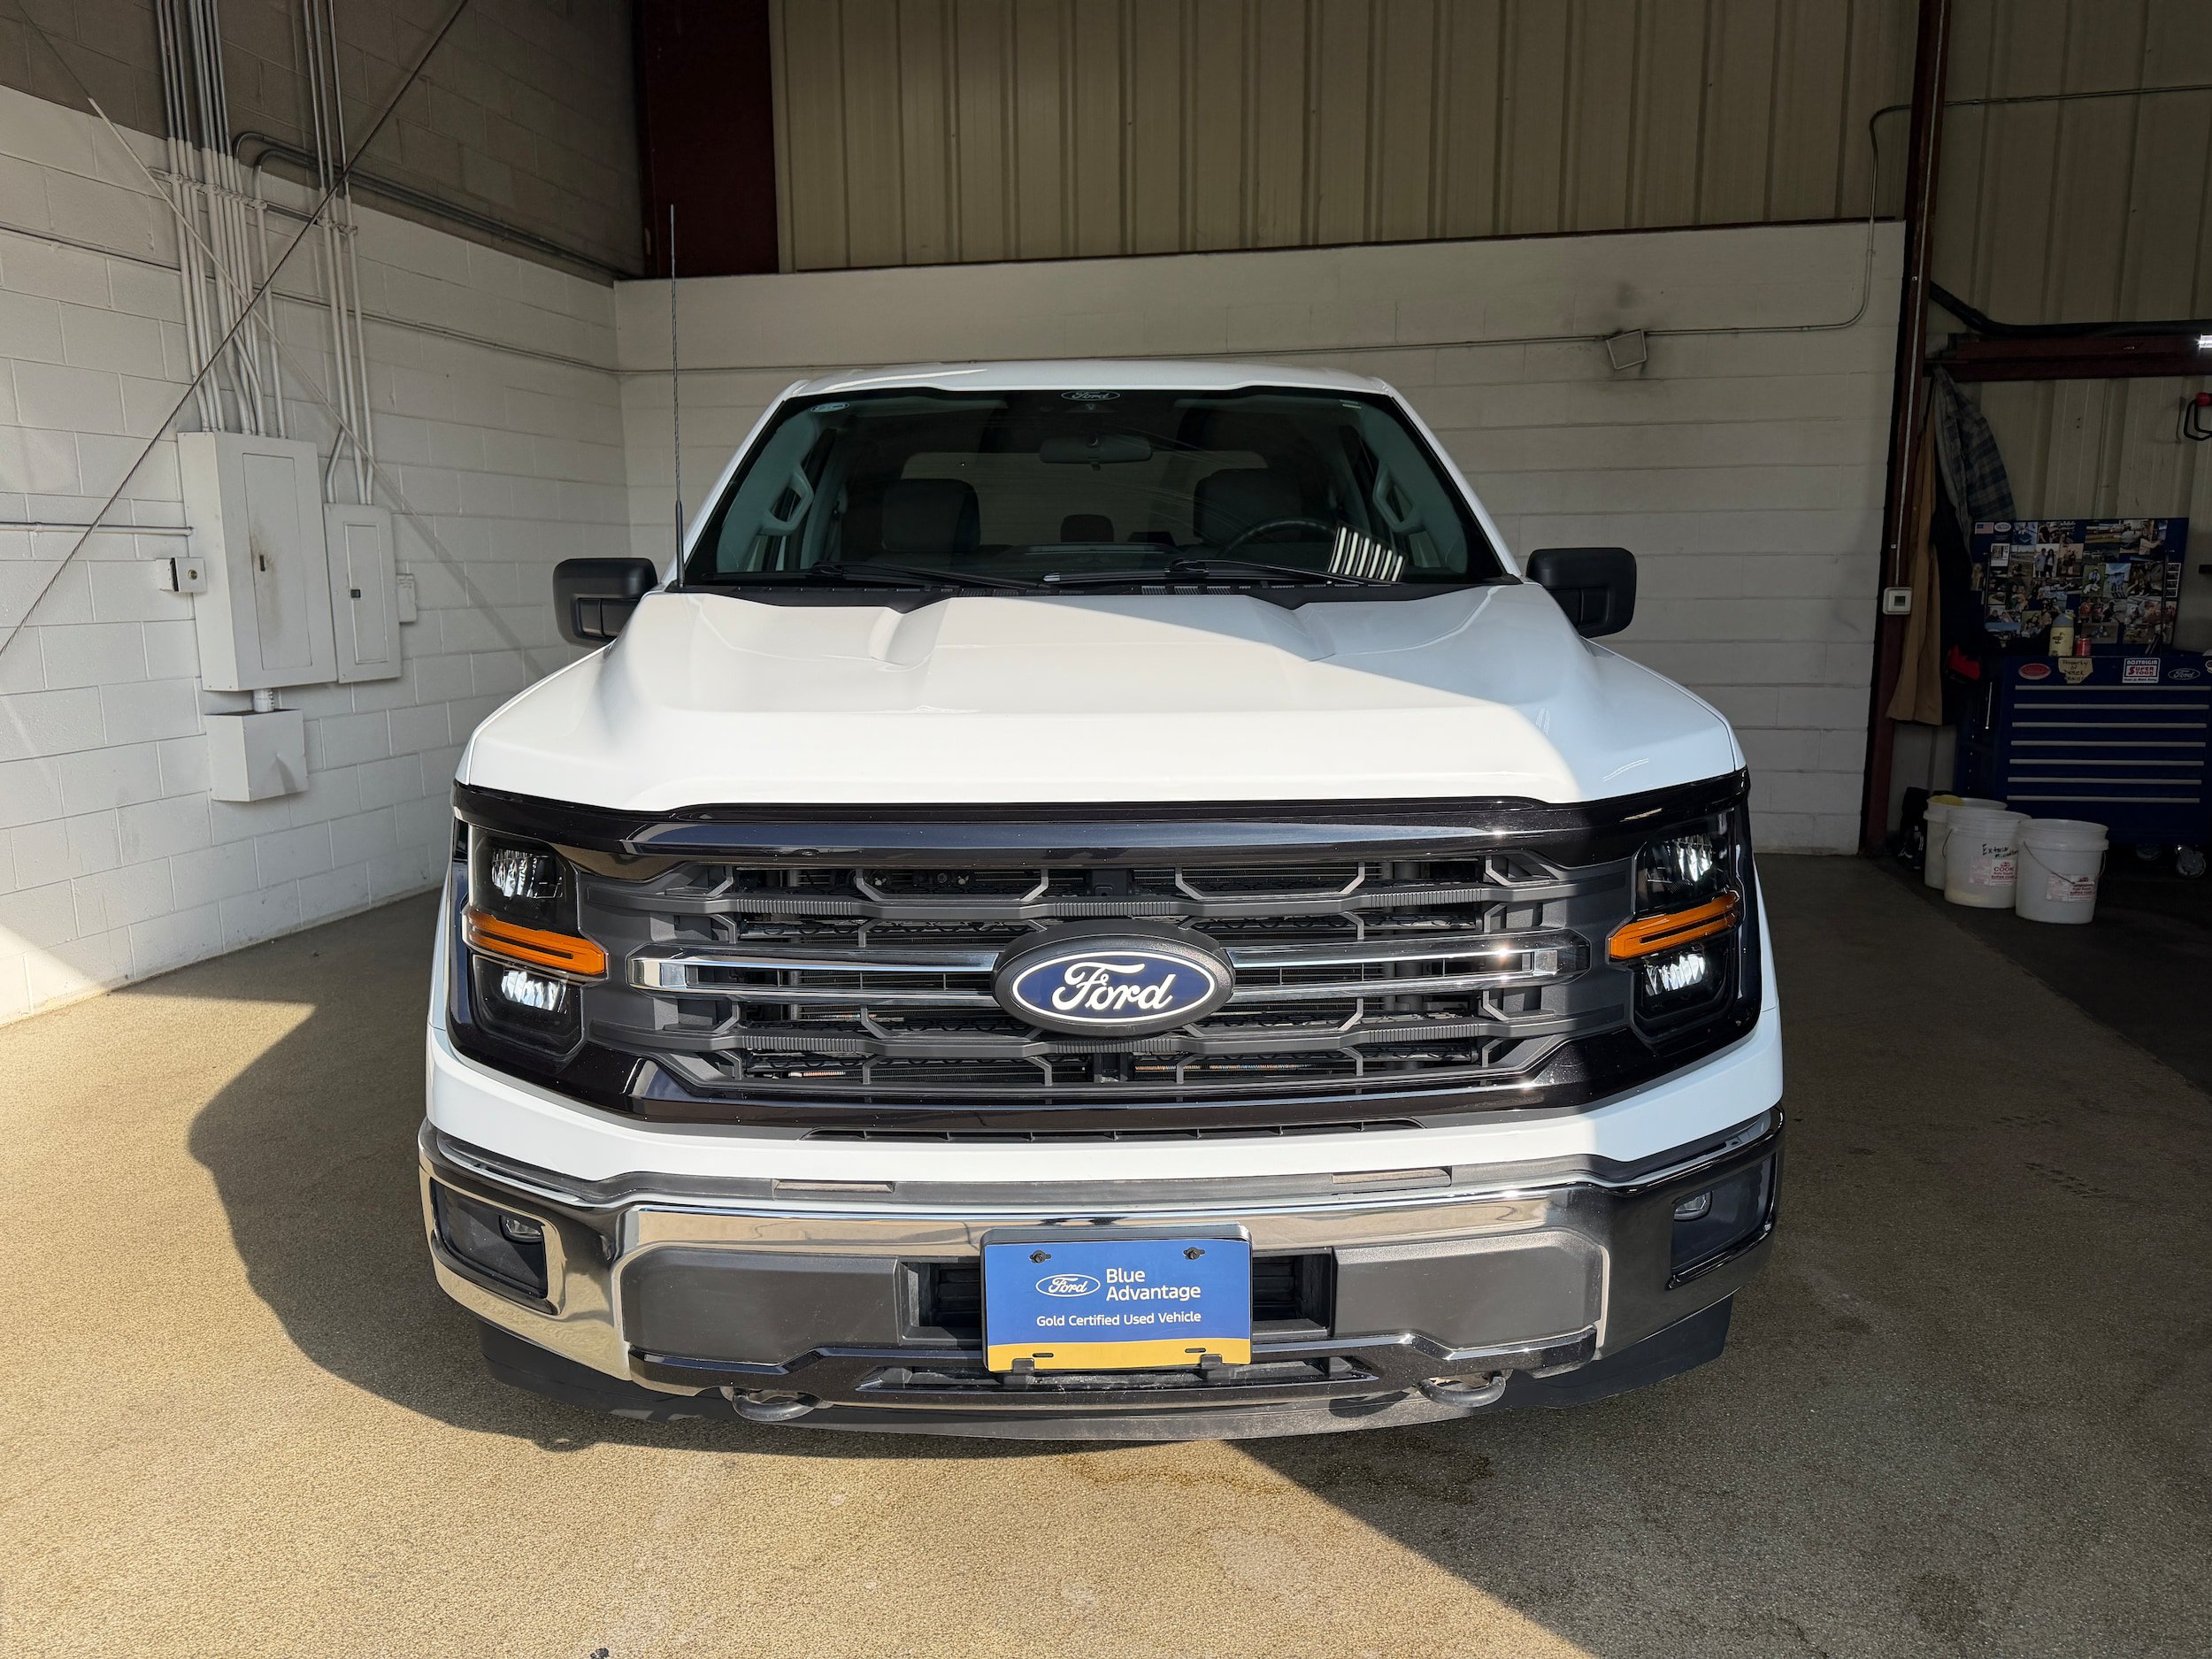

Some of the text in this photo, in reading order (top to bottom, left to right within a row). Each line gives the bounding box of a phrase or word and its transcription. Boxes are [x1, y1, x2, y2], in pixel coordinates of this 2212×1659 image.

[1052, 962, 1176, 1010] Ford
[1048, 1267, 1146, 1294] Ford Blue
[1106, 1285, 1202, 1302] Advantage
[1036, 1311, 1202, 1326] Gold Certified Used Vehicle
